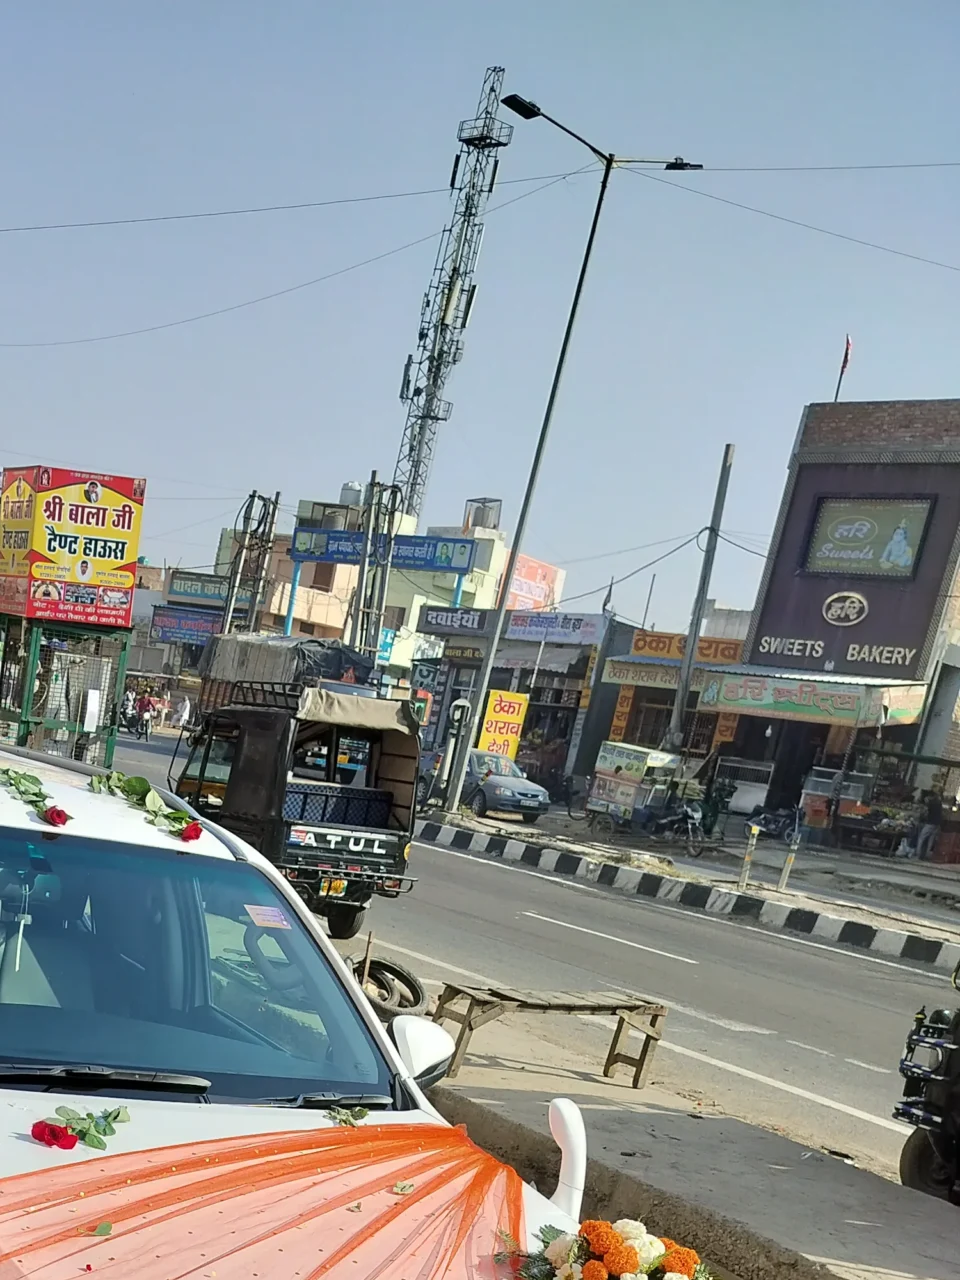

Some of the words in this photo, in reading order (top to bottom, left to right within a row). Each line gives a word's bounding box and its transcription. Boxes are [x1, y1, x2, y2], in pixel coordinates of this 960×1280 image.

[44, 495, 65, 522] श्री
[69, 503, 108, 527] बाला
[112, 504, 134, 530] जी
[835, 521, 870, 538] हरि
[45, 525, 79, 555] टैण्ट
[83, 537, 128, 560] हाऊस
[817, 543, 873, 559] Sweets
[828, 598, 862, 620] हरि
[634, 629, 675, 653] ठेका
[759, 636, 825, 657] SWEETS
[847, 644, 916, 666] BAKERY
[609, 663, 629, 680] ठेका
[632, 669, 658, 684] शराब
[723, 676, 767, 700] हरि
[493, 694, 522, 716] ठेका
[485, 720, 522, 737] शराब
[488, 739, 510, 755] देशी
[301, 832, 386, 854] ATUL
